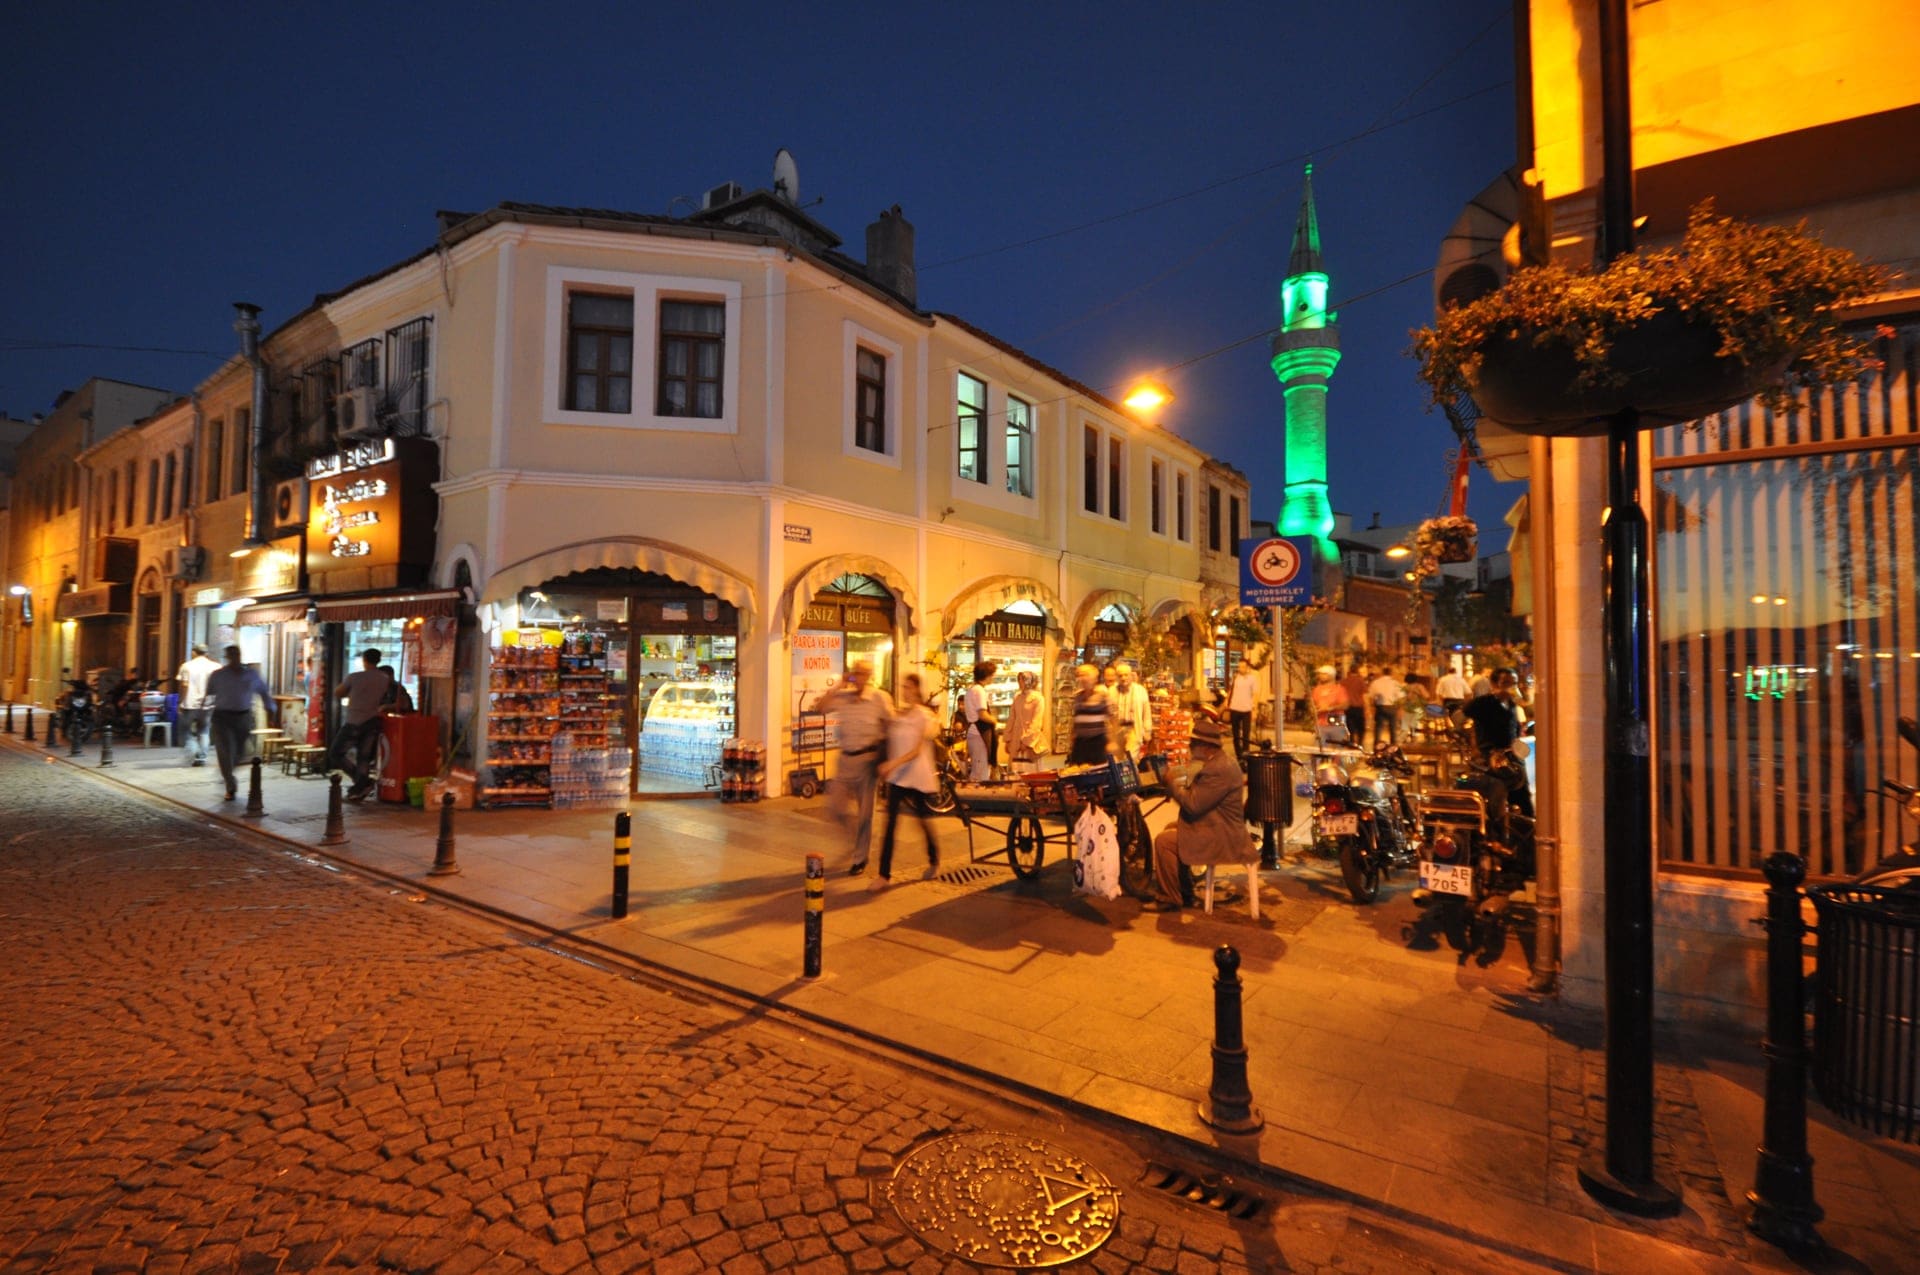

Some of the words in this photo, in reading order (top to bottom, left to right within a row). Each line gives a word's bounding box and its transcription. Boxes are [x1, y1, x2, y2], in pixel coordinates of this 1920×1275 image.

[983, 621, 1002, 637] TAT
[1007, 623, 1042, 640] HAMUR
[1432, 878, 1459, 892] 705
